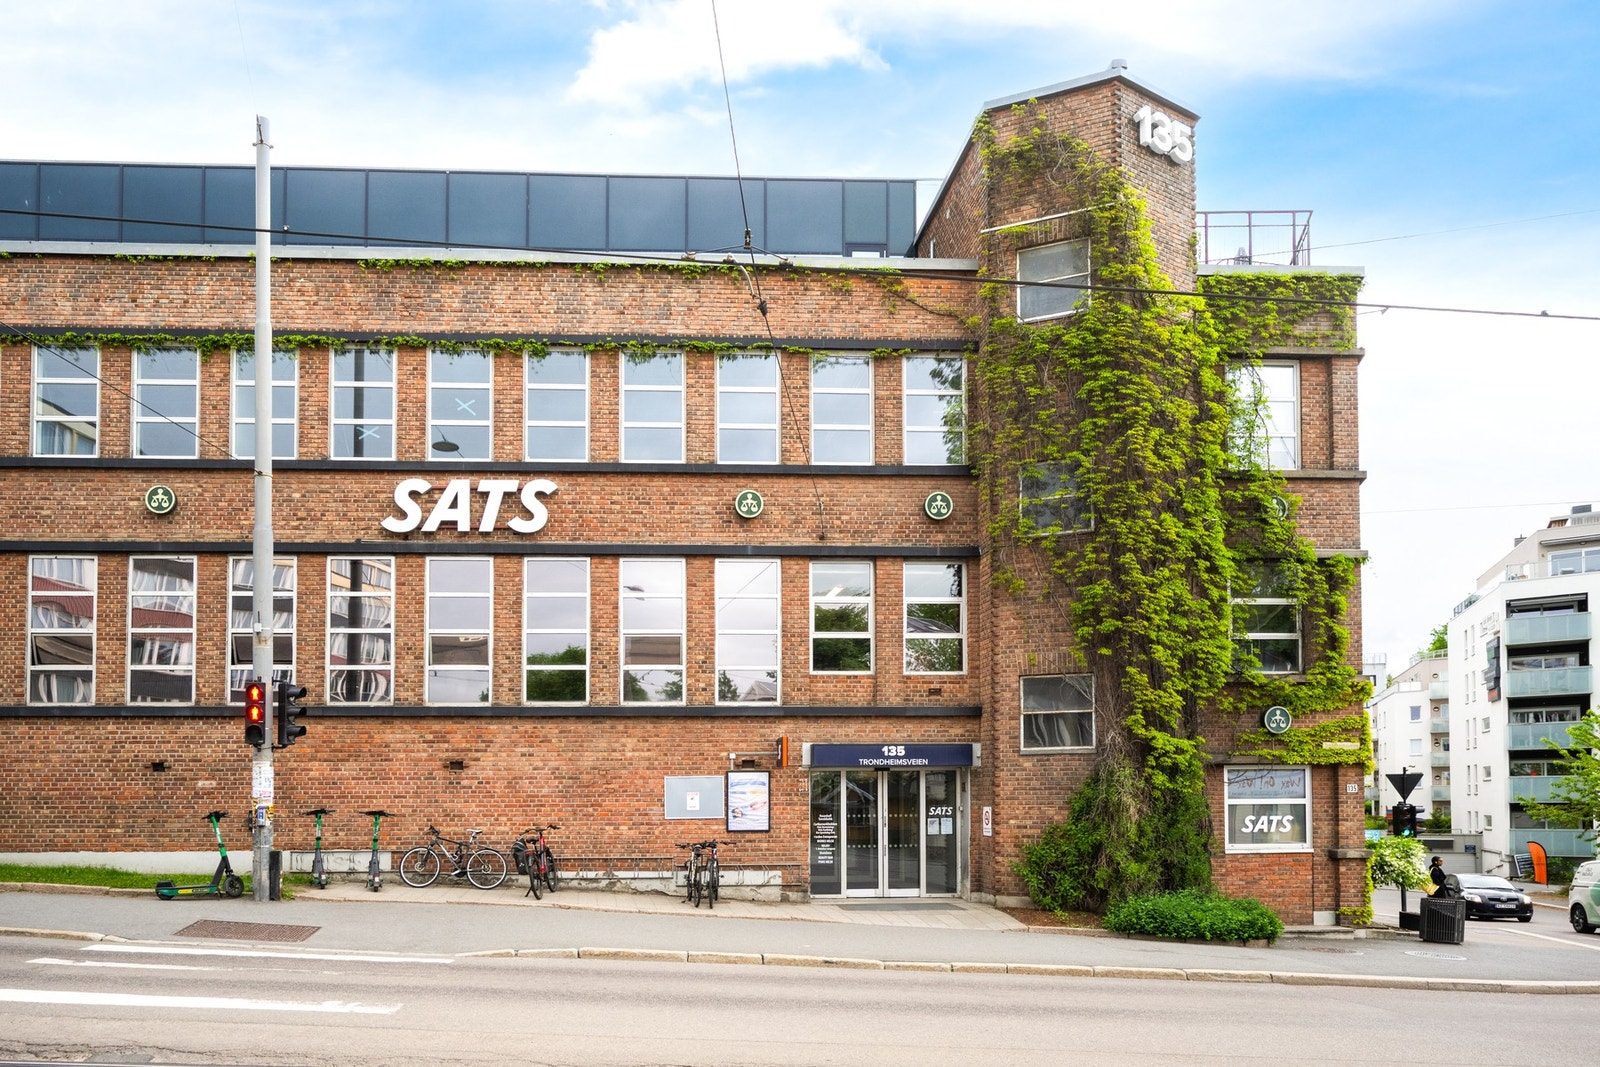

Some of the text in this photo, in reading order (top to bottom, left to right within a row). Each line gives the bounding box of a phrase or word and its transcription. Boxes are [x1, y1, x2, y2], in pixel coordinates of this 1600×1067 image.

[1133, 105, 1193, 166] 135
[380, 478, 558, 534] SATS
[882, 746, 905, 757] 135
[929, 807, 952, 816] SATS
[1241, 815, 1294, 833] SATS
